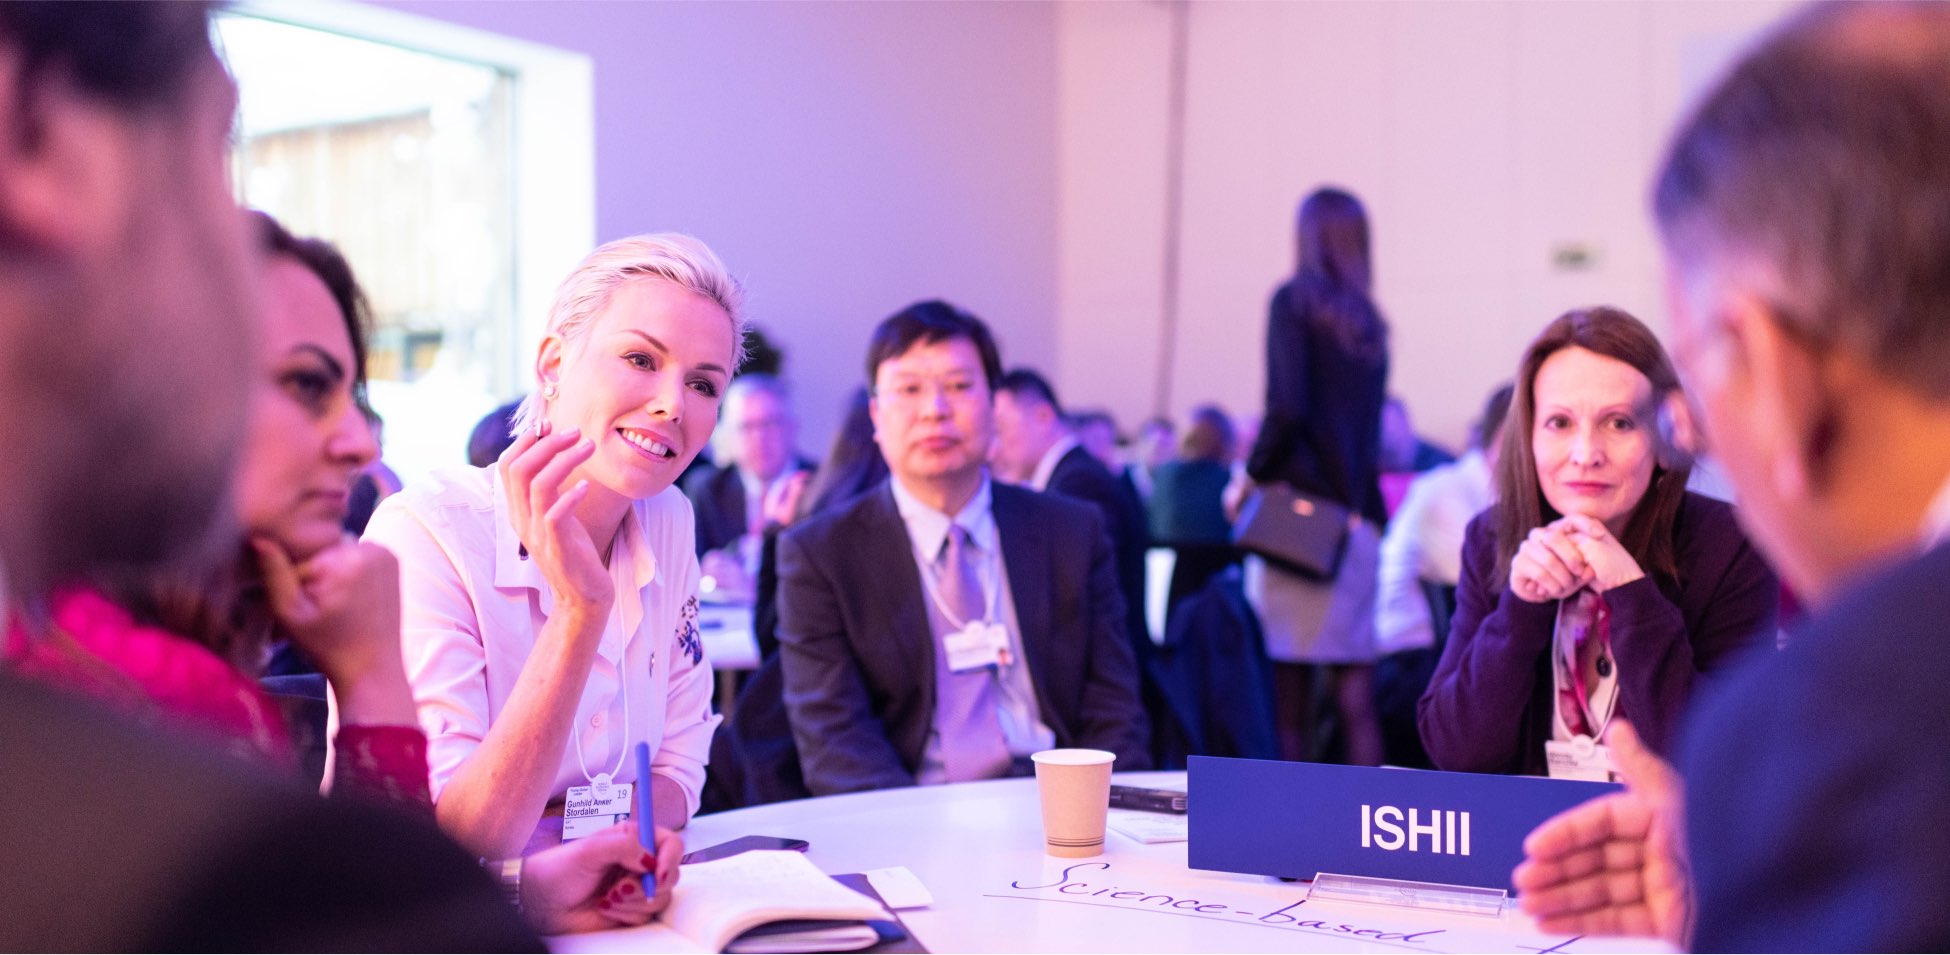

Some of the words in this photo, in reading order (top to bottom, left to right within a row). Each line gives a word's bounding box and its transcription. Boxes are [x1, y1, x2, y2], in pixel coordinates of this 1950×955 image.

[617, 789, 627, 799] 19
[567, 799, 592, 808] Gunhild
[566, 808, 599, 817] Stordalen
[1361, 804, 1470, 856] ISHII
[1011, 862, 1447, 943] Science-based
